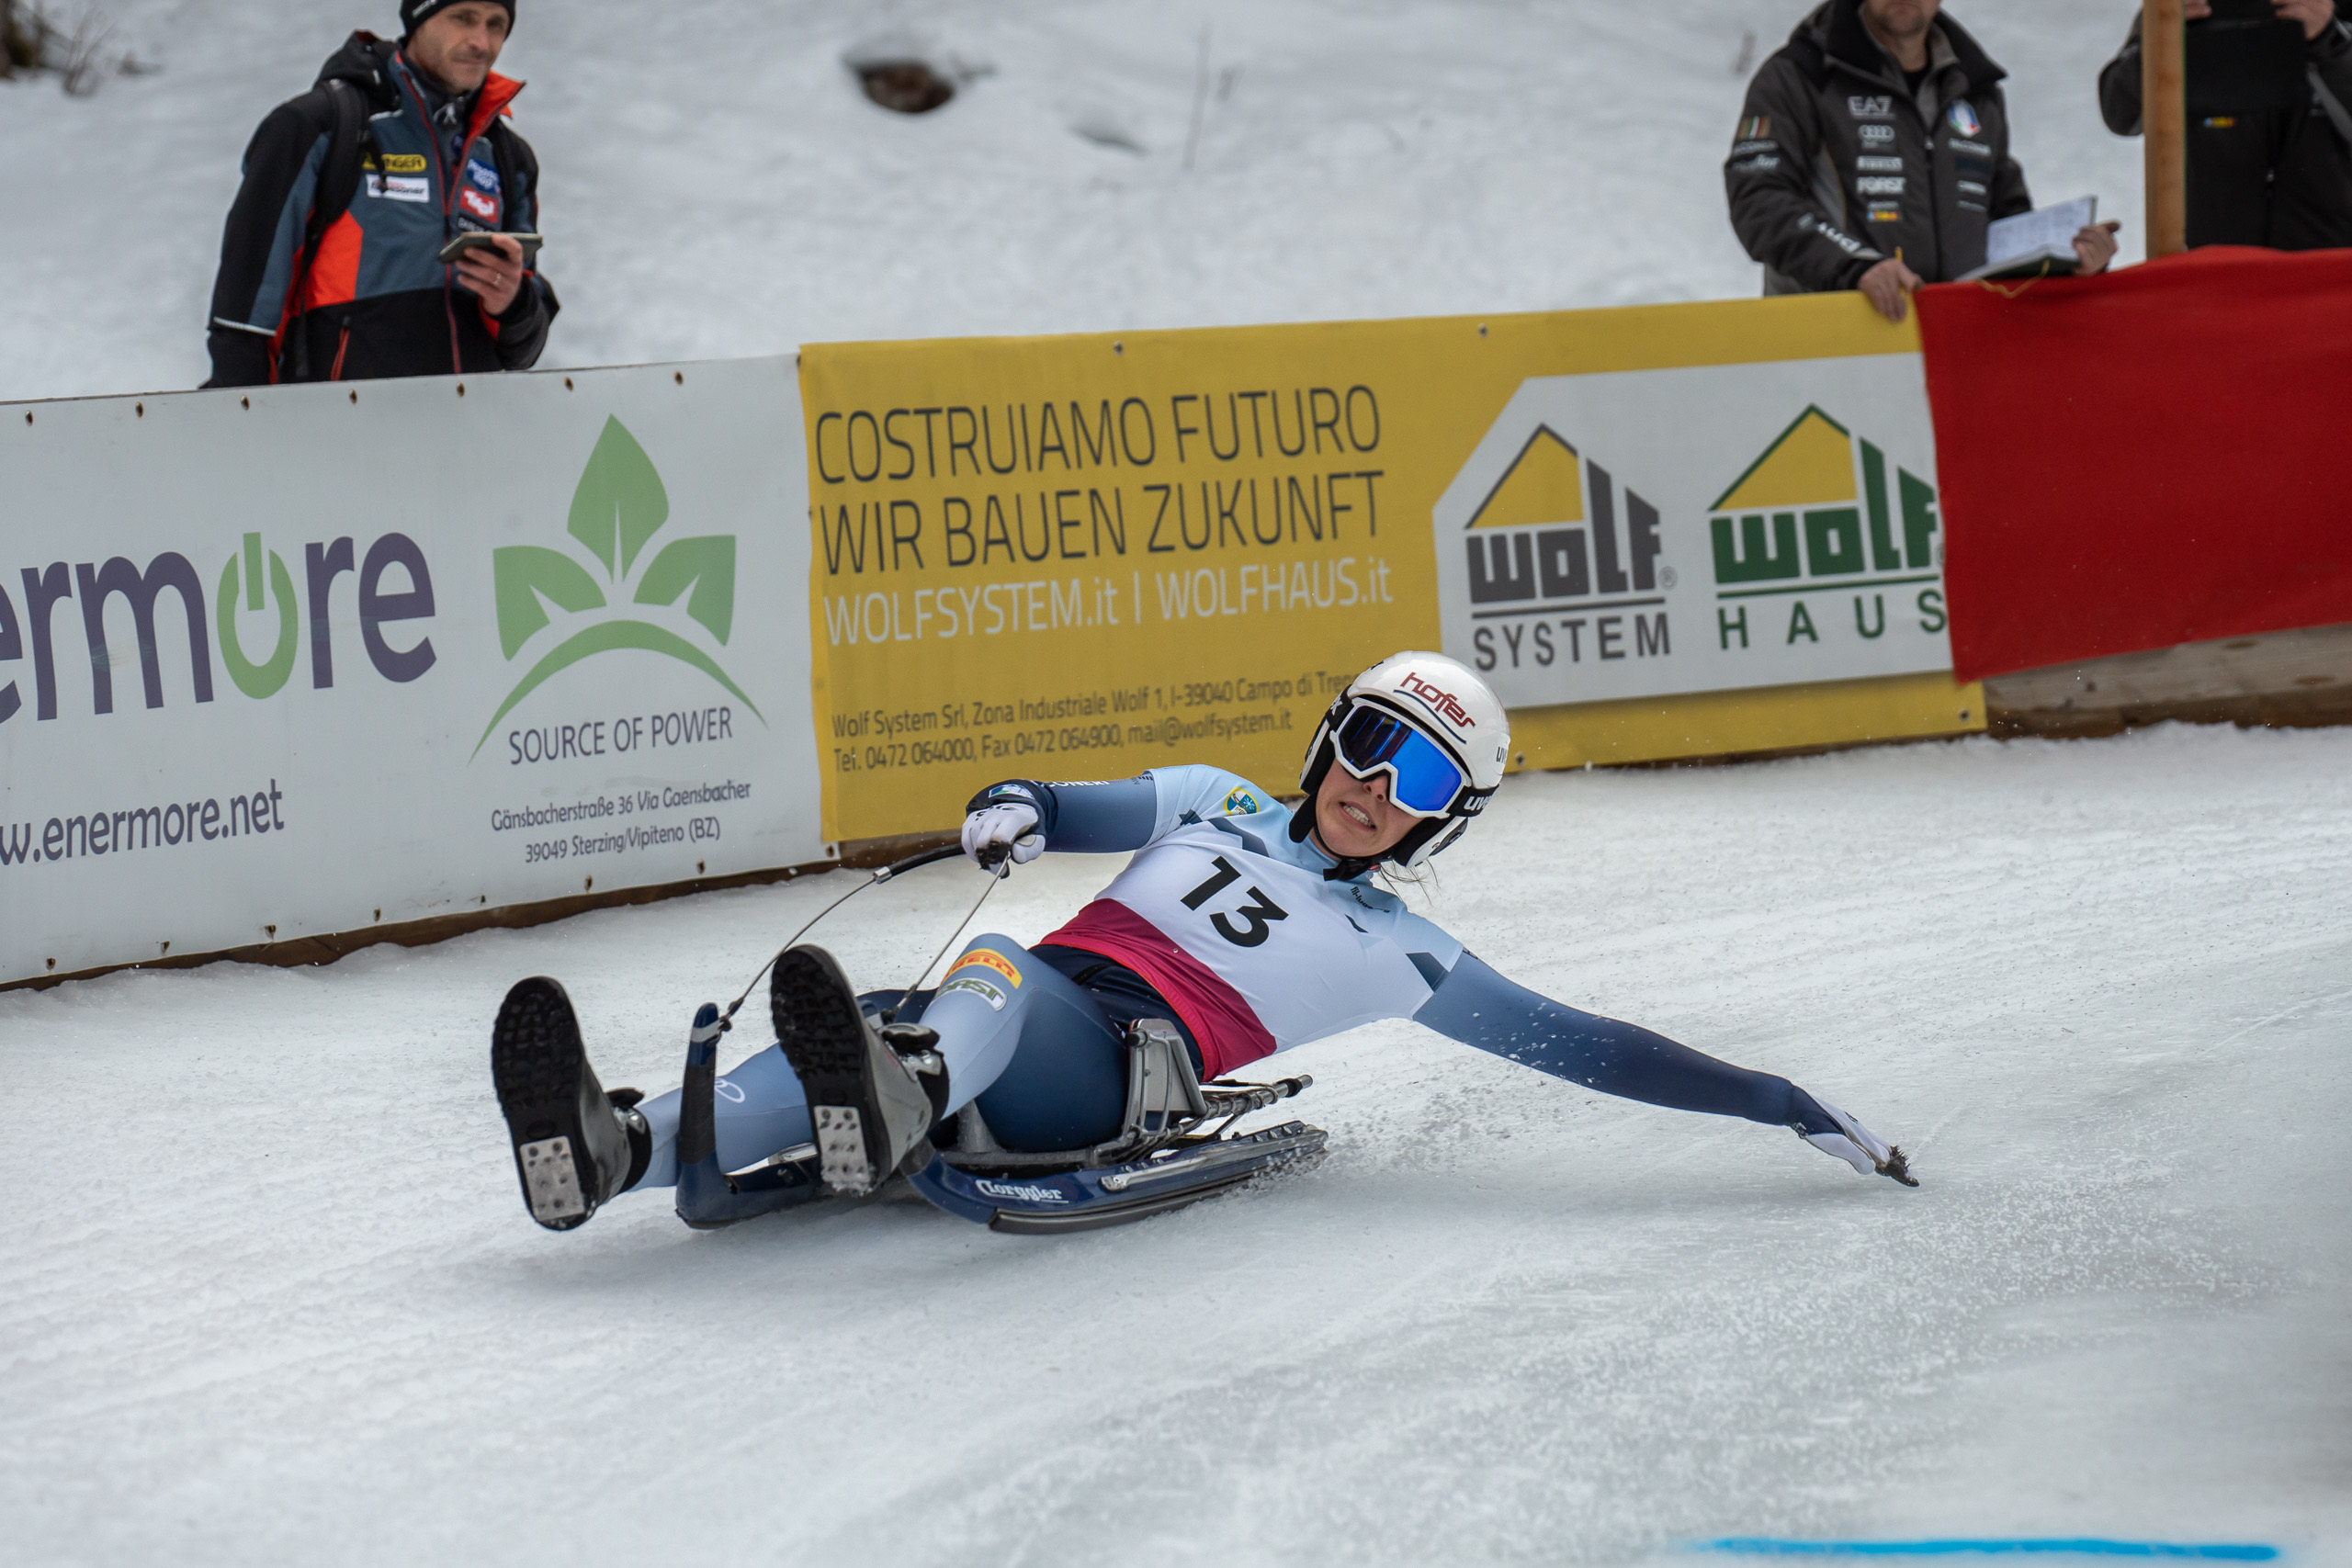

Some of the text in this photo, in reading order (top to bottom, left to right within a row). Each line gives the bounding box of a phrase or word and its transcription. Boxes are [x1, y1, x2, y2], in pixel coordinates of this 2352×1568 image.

[1848, 96, 1893, 116] EA7
[816, 384, 1380, 484] COSTRUIAMO FUTURO
[820, 469, 1385, 575] WIR BAUEN ZUKUNFT
[824, 576, 1119, 646] WOLFSYSTEM.it
[1155, 555, 1394, 621] WOLFHAUS.it
[1718, 588, 1948, 650] HAUS
[1474, 611, 1672, 673] SYSTEM
[831, 710, 870, 739] Wolf
[874, 709, 938, 740] System
[972, 701, 1015, 727] Zona
[1019, 690, 1108, 721] Industriale
[1111, 685, 1149, 714] Wolf
[1236, 677, 1294, 705] Campo
[1296, 672, 1314, 697] di
[1399, 671, 1476, 728] hofer
[509, 705, 733, 765] SOURCE OF POWER
[833, 746, 862, 773] Tel.
[865, 743, 908, 771] 0472
[910, 737, 978, 765] 064000,
[981, 733, 1011, 760] Fax
[1014, 729, 1056, 755] 0472
[1127, 706, 1293, 748] mail@wolfsystem.it
[492, 779, 752, 831] Gänsbacherstraße 36 Via Gaensbacher
[525, 816, 721, 863] 39049 Sterzing/Vipiteno (BZ)
[1181, 855, 1290, 948] 13
